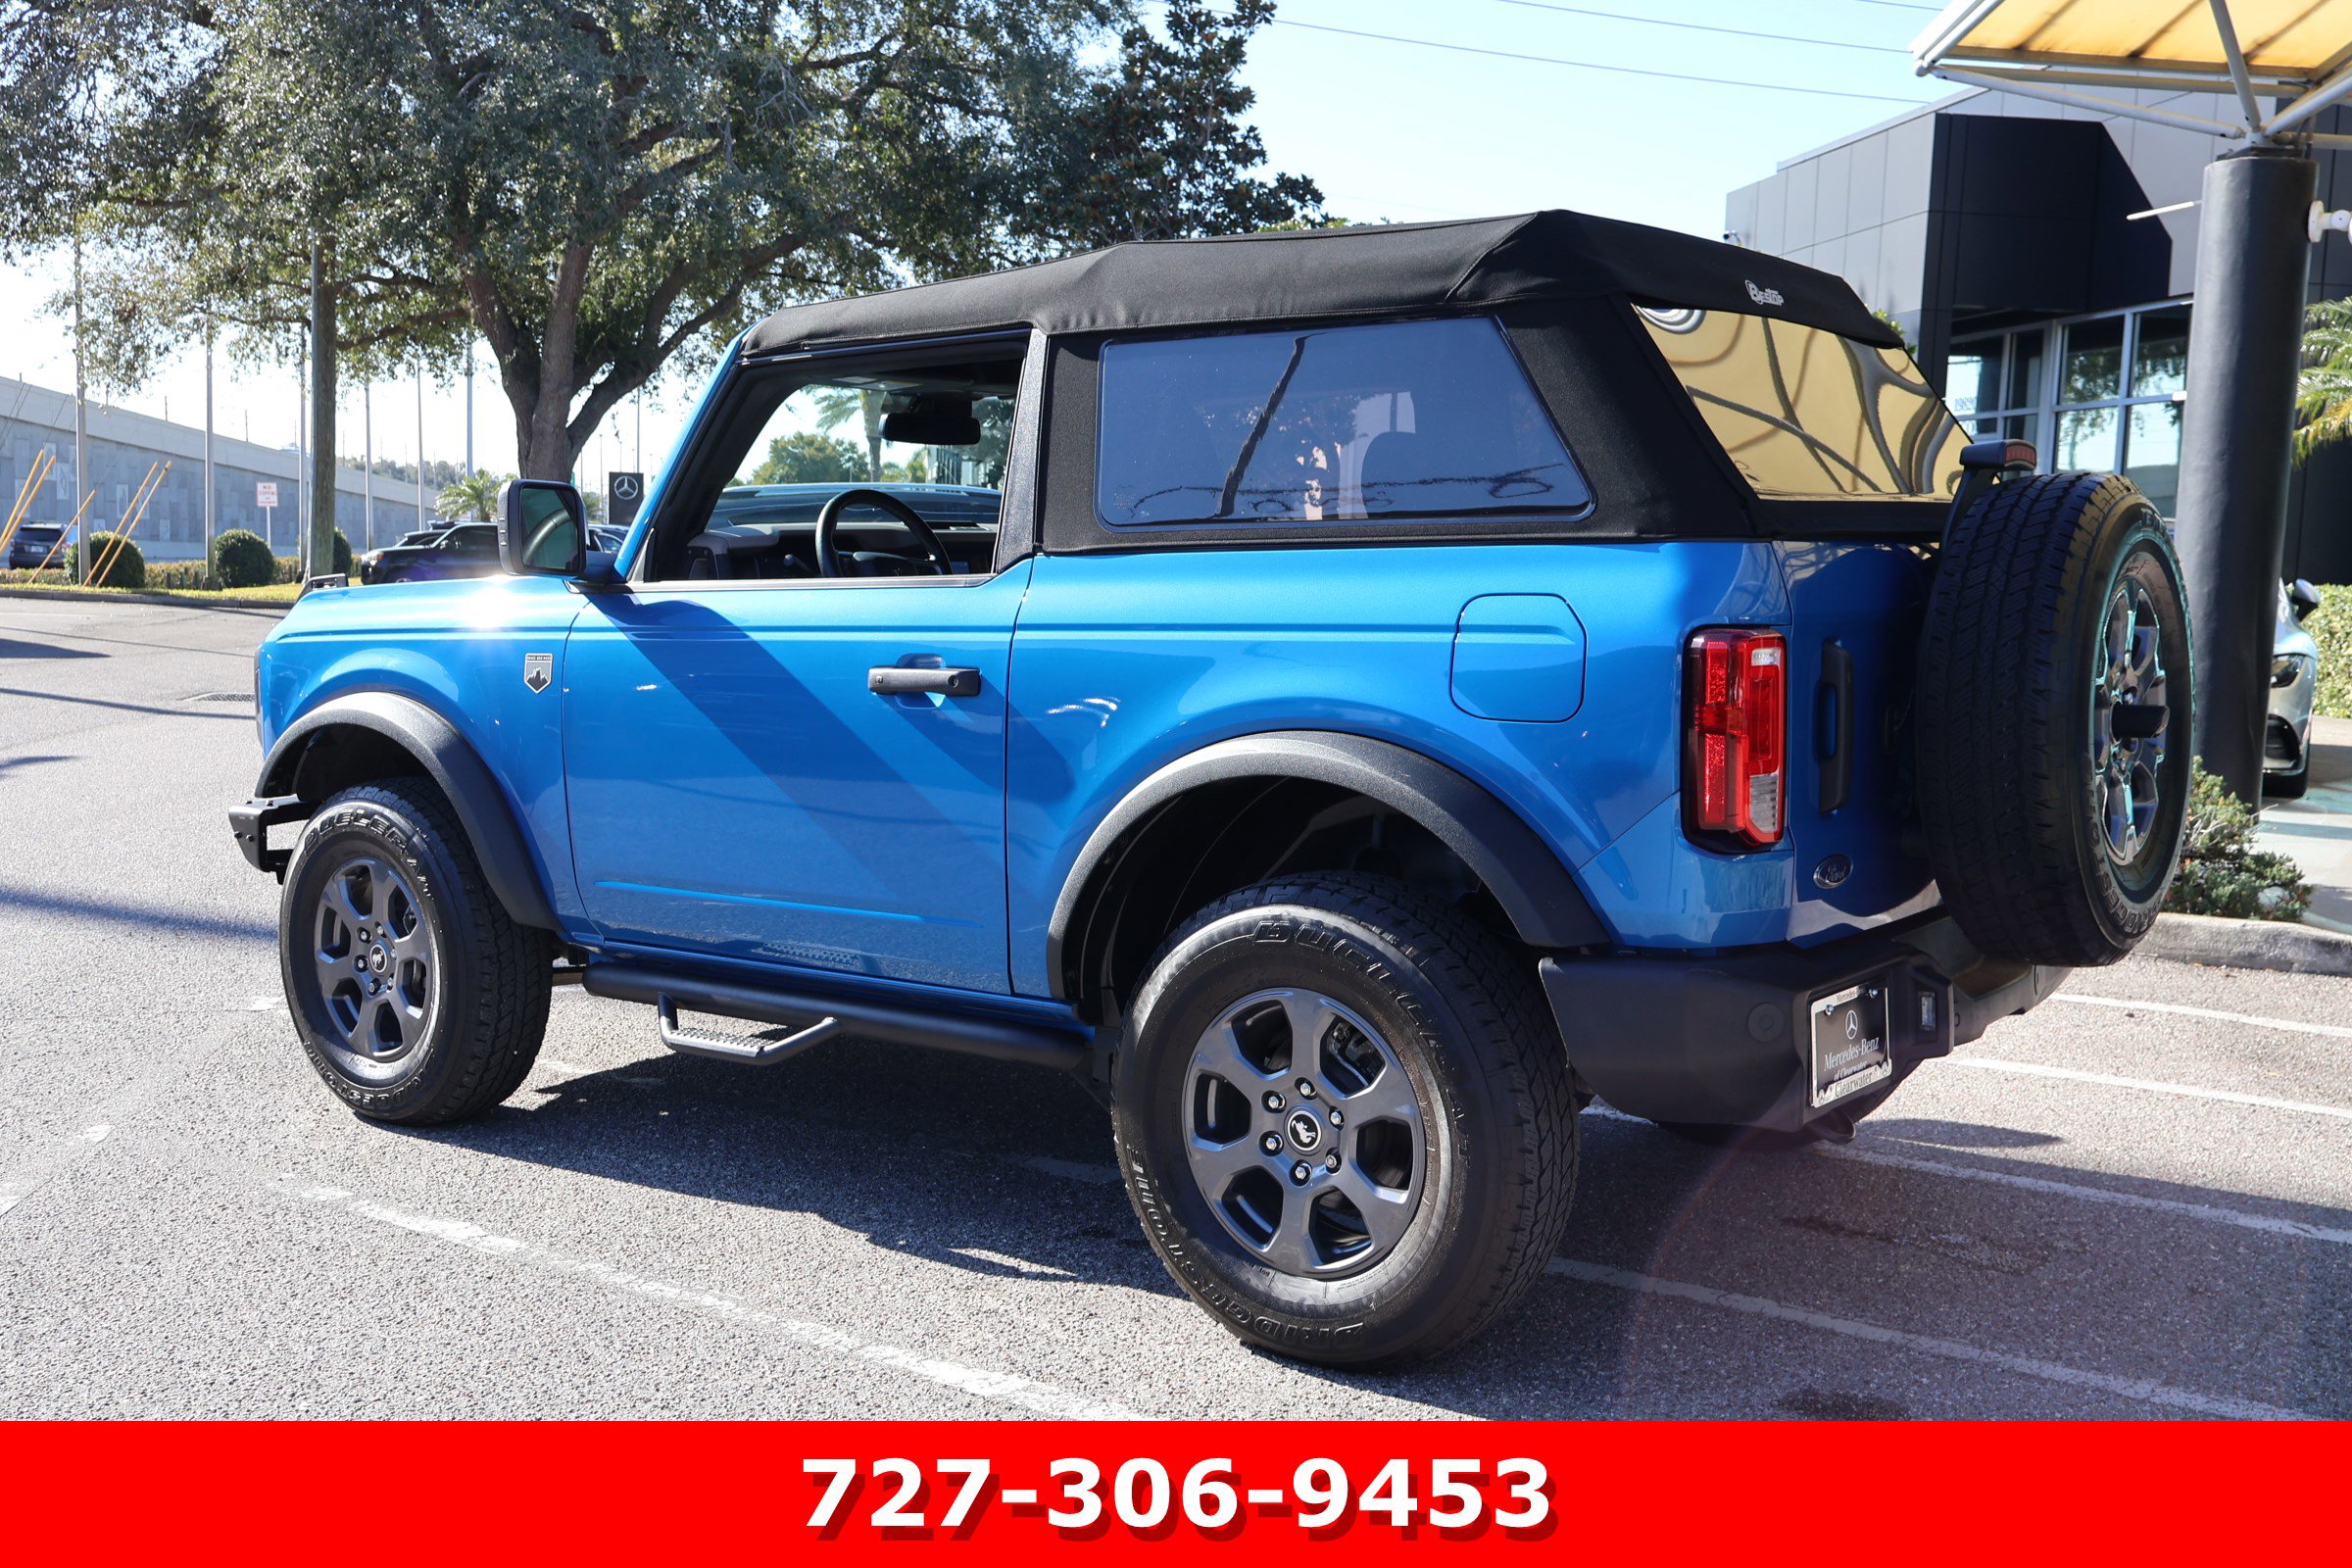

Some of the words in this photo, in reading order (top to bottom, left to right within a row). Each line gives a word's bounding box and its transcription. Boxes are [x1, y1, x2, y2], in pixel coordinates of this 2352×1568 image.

[305, 808, 408, 850] DUELER
[1825, 863, 1846, 882] Ford
[1824, 1037, 1880, 1071] Mercedes-Benz
[1834, 1069, 1840, 1081] of
[1839, 1060, 1868, 1078] Clearwater
[1835, 1071, 1873, 1098] Clearwater
[1127, 1144, 1365, 1347] BRIDGESTONE
